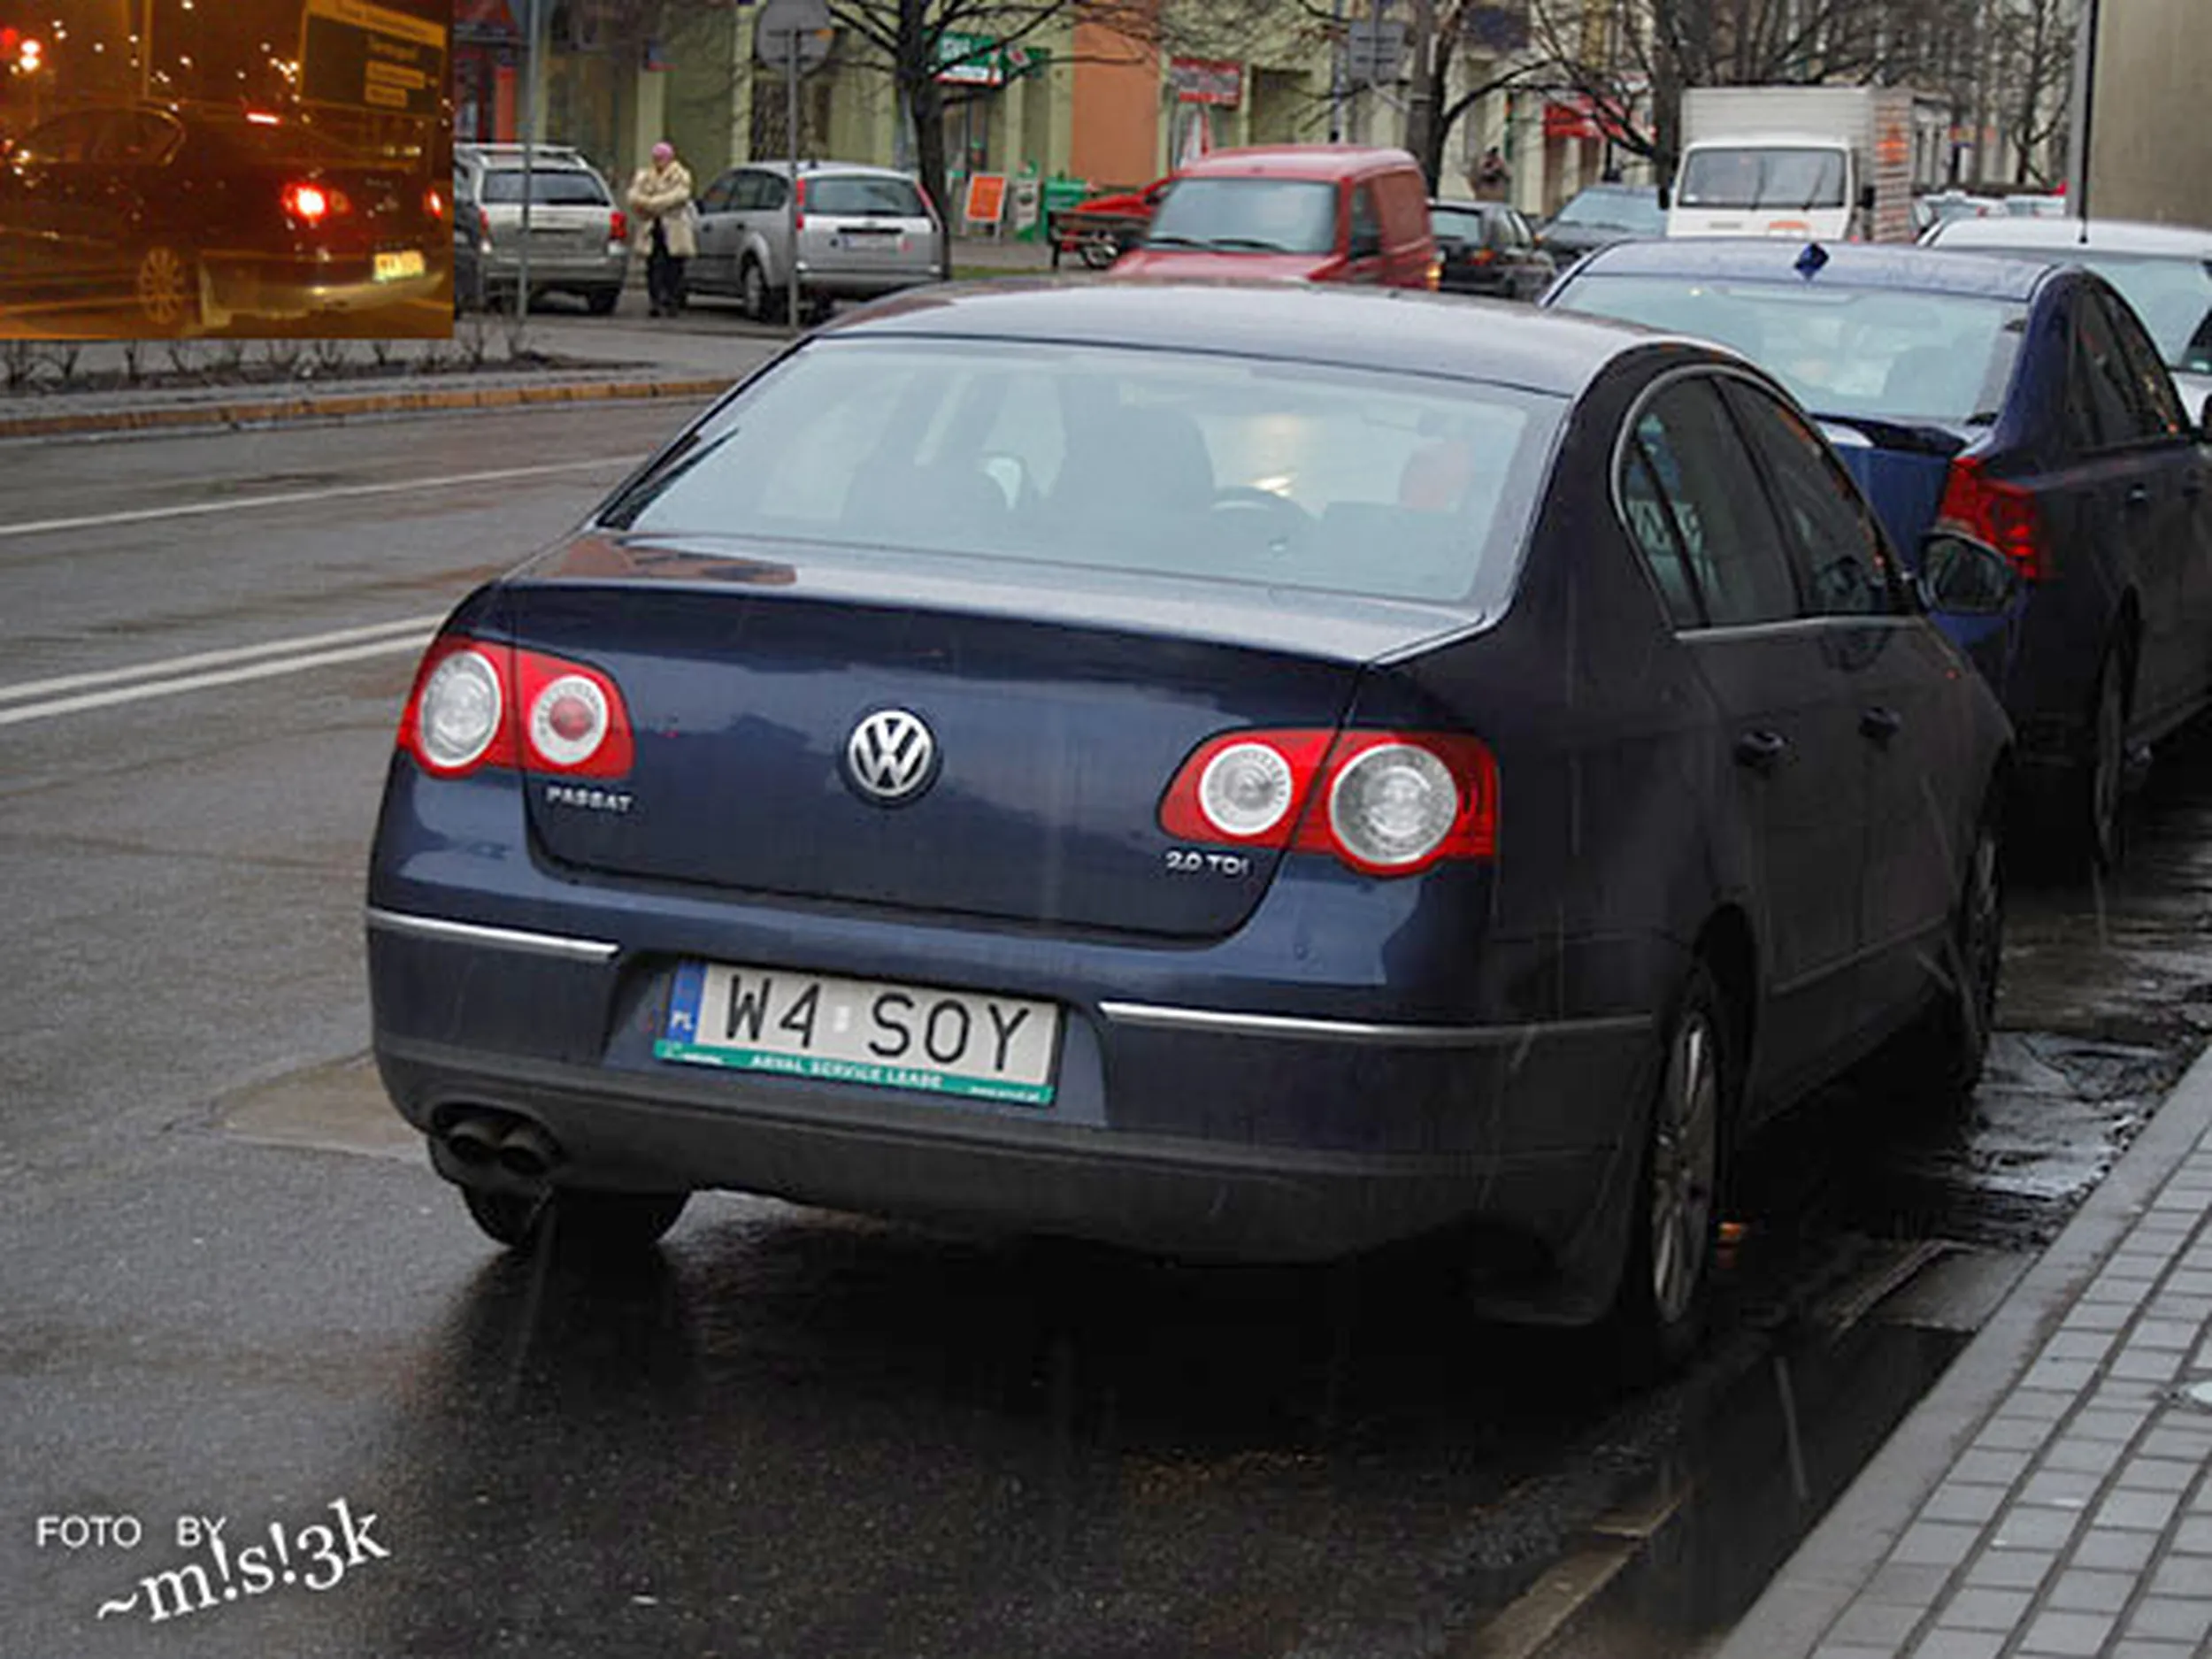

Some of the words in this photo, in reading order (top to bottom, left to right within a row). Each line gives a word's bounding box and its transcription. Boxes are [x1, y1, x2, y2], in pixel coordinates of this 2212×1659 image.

[546, 786, 634, 812] PASSAT
[1206, 854, 1248, 875] TDI
[726, 974, 820, 1049] W4
[868, 992, 1030, 1071] SOY
